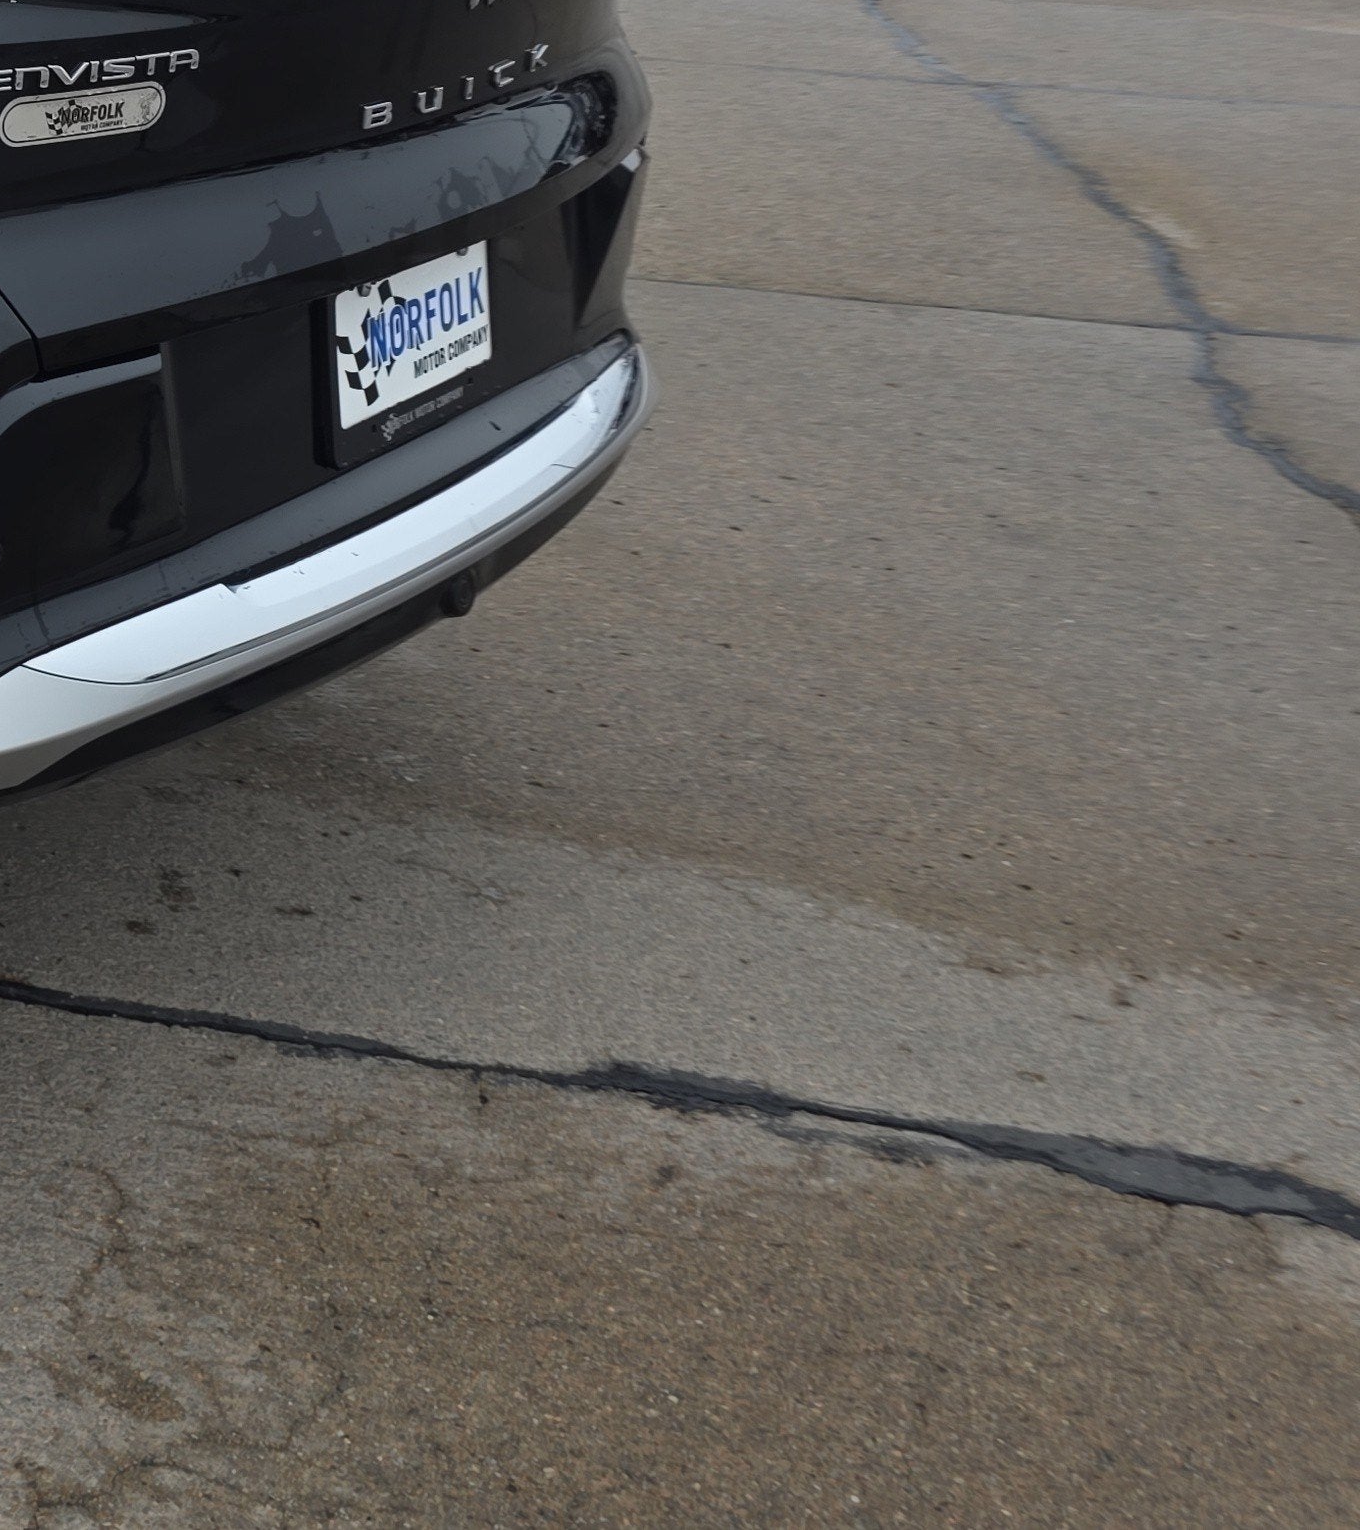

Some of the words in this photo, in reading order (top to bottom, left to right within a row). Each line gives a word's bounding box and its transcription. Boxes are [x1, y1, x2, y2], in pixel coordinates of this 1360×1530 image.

[59, 100, 126, 129] NORFOLK
[363, 43, 549, 130] BUICK
[369, 266, 485, 369] NORFOLK
[413, 346, 447, 379] MOTOR
[448, 323, 489, 361] COMPANY
